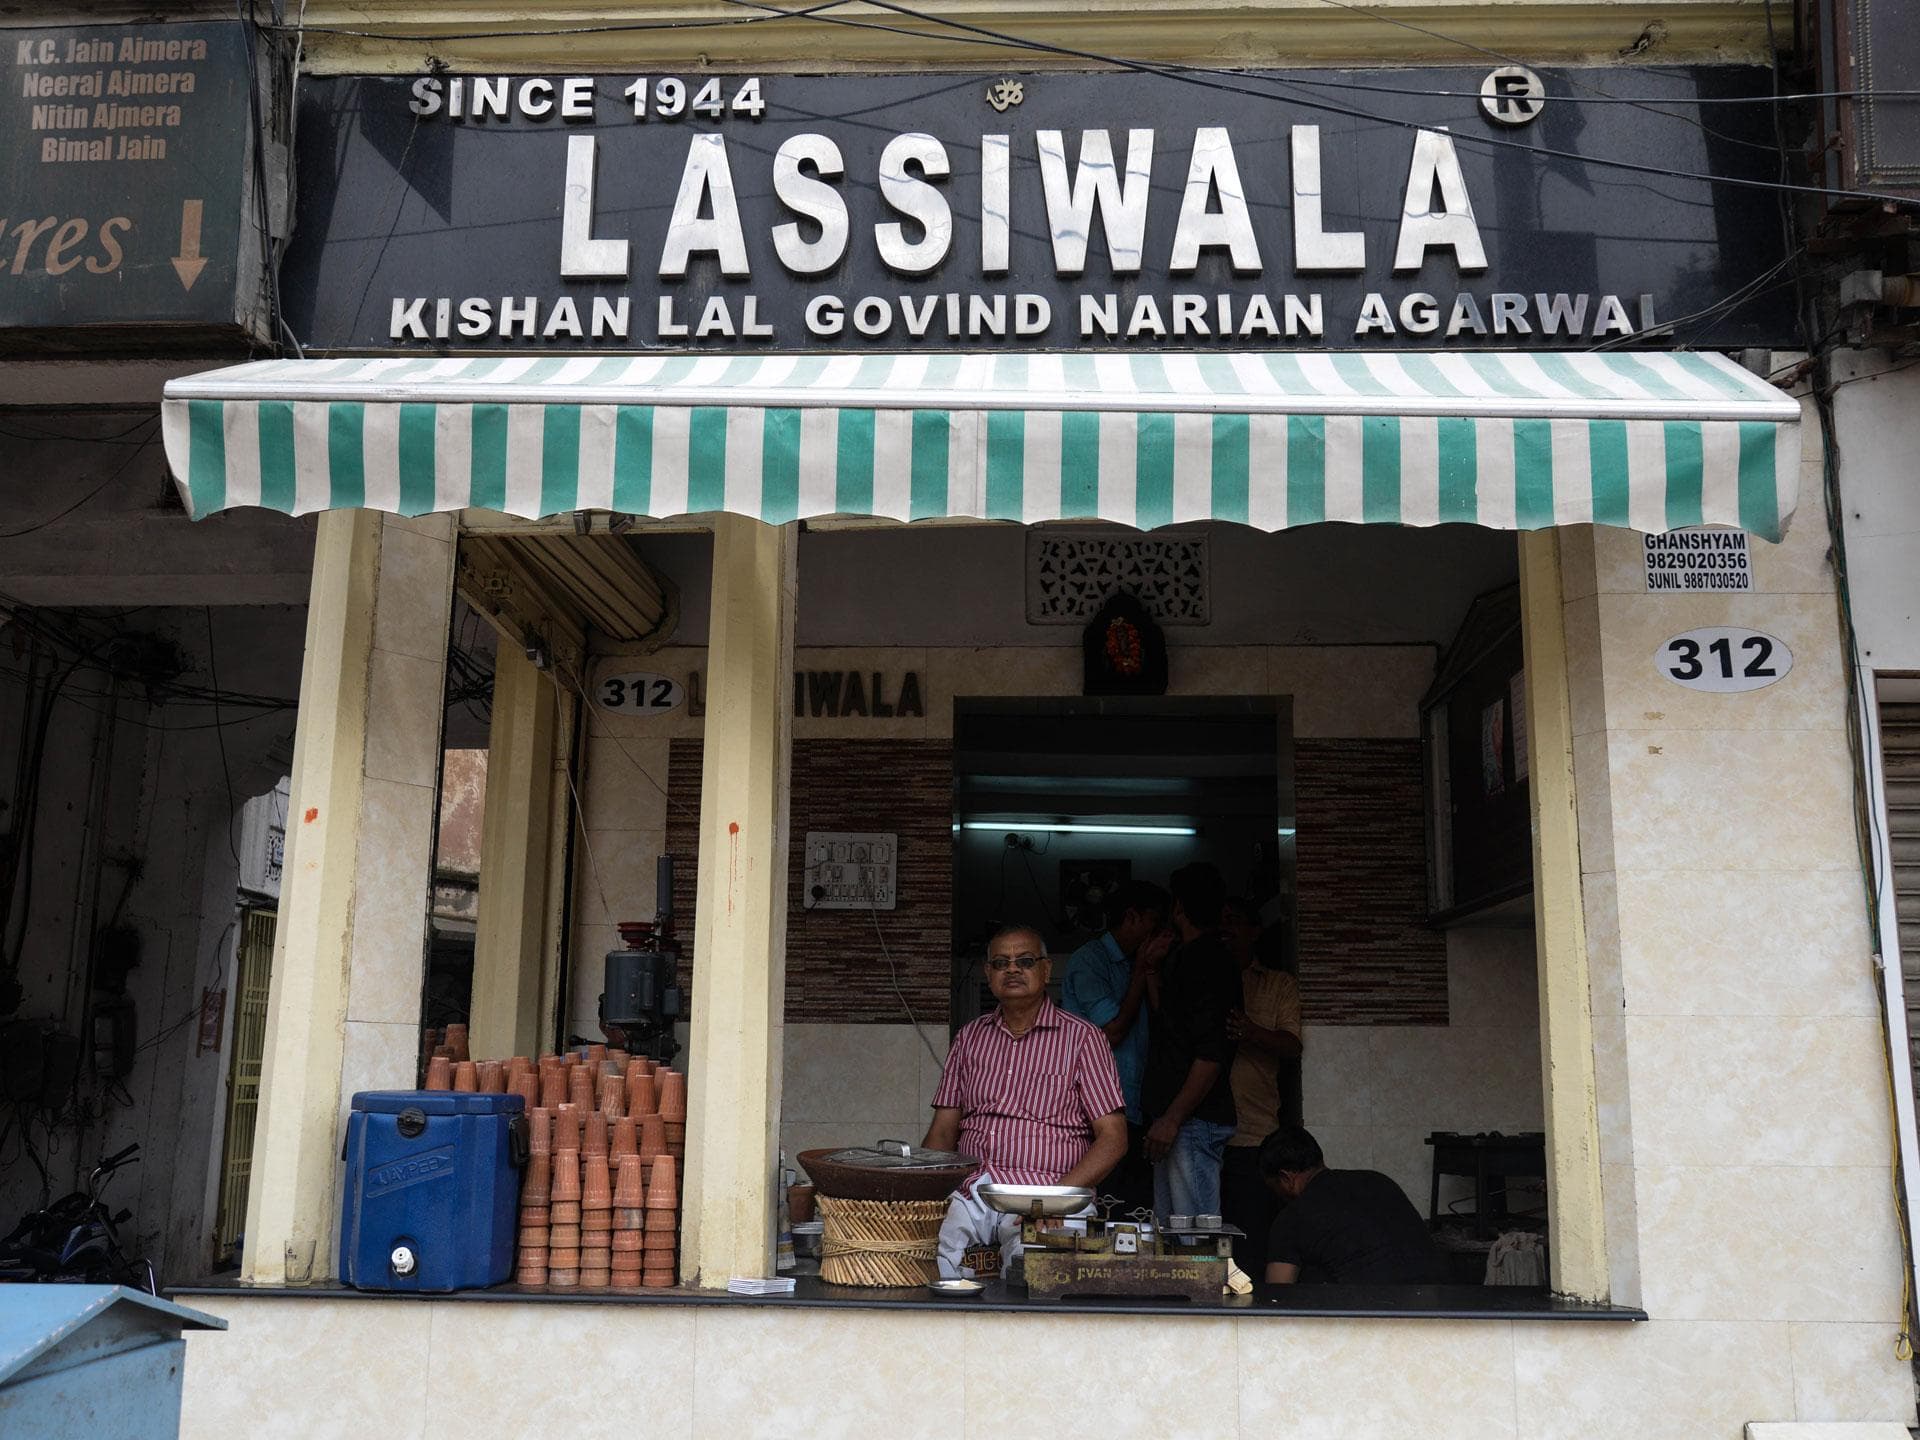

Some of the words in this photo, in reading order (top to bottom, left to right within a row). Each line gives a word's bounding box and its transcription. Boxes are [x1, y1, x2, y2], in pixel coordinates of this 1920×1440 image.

[17, 39, 60, 65] K.C.
[64, 38, 114, 63] Jain
[118, 36, 207, 65] Ajmera
[22, 71, 102, 97] Neeraj
[107, 69, 196, 97] Ajmera
[408, 77, 594, 120] SINCE
[624, 76, 765, 119] 1944
[31, 104, 88, 130] Nitin
[93, 103, 182, 130] Ajmera
[41, 136, 112, 163] Bimal
[116, 135, 167, 161] Jain
[560, 124, 1489, 279] LASSIWALA
[0, 214, 132, 276] res
[389, 297, 631, 340] KISHAN
[657, 295, 774, 339] LAL
[804, 294, 1052, 338] GOVIND
[1079, 293, 1324, 338] NARIAN
[1354, 292, 1674, 337] AGARWAL
[1645, 533, 1746, 550] GHANSHYAM
[1646, 552, 1747, 569] 9829020356
[1648, 573, 1682, 589] SUNIL
[1684, 572, 1749, 589] 9887030520
[1668, 636, 1777, 681] 312
[602, 678, 673, 707] 312
